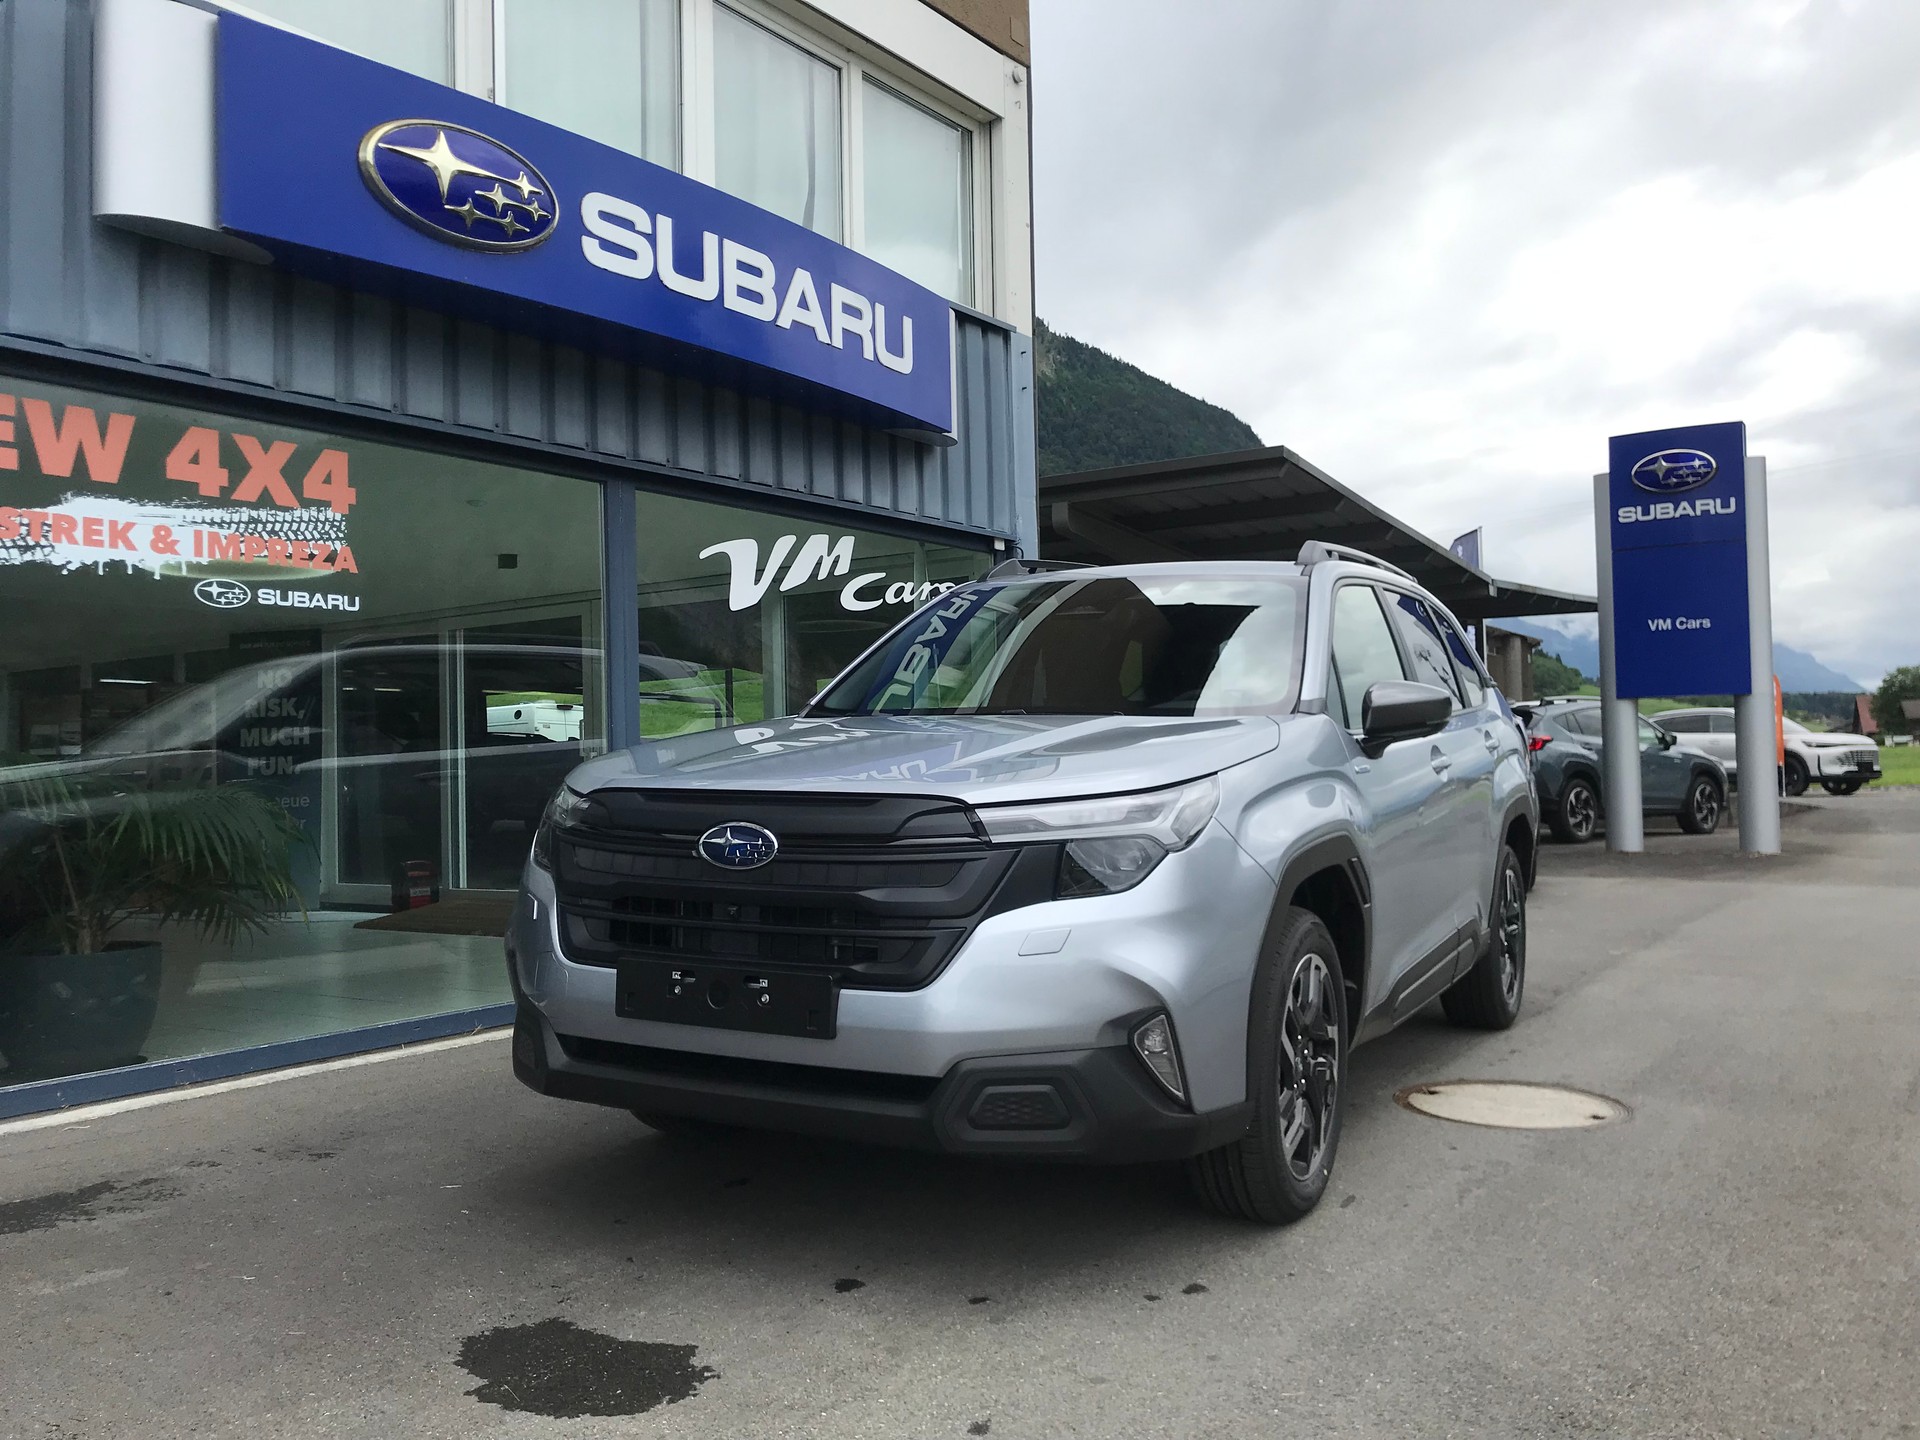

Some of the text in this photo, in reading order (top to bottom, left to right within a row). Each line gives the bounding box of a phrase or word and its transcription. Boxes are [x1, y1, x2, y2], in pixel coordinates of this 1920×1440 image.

[580, 192, 913, 375] SUBARU
[166, 426, 356, 514] 4X4
[1618, 497, 1736, 523] SUBARU
[150, 524, 181, 556] &
[193, 529, 358, 574] IMPREZA
[699, 534, 855, 611] VM
[257, 588, 360, 611] SUBARU
[1648, 616, 1711, 632] VM Cars
[257, 669, 293, 689] NO
[245, 698, 305, 719] RISK,
[240, 726, 310, 747] MUCH
